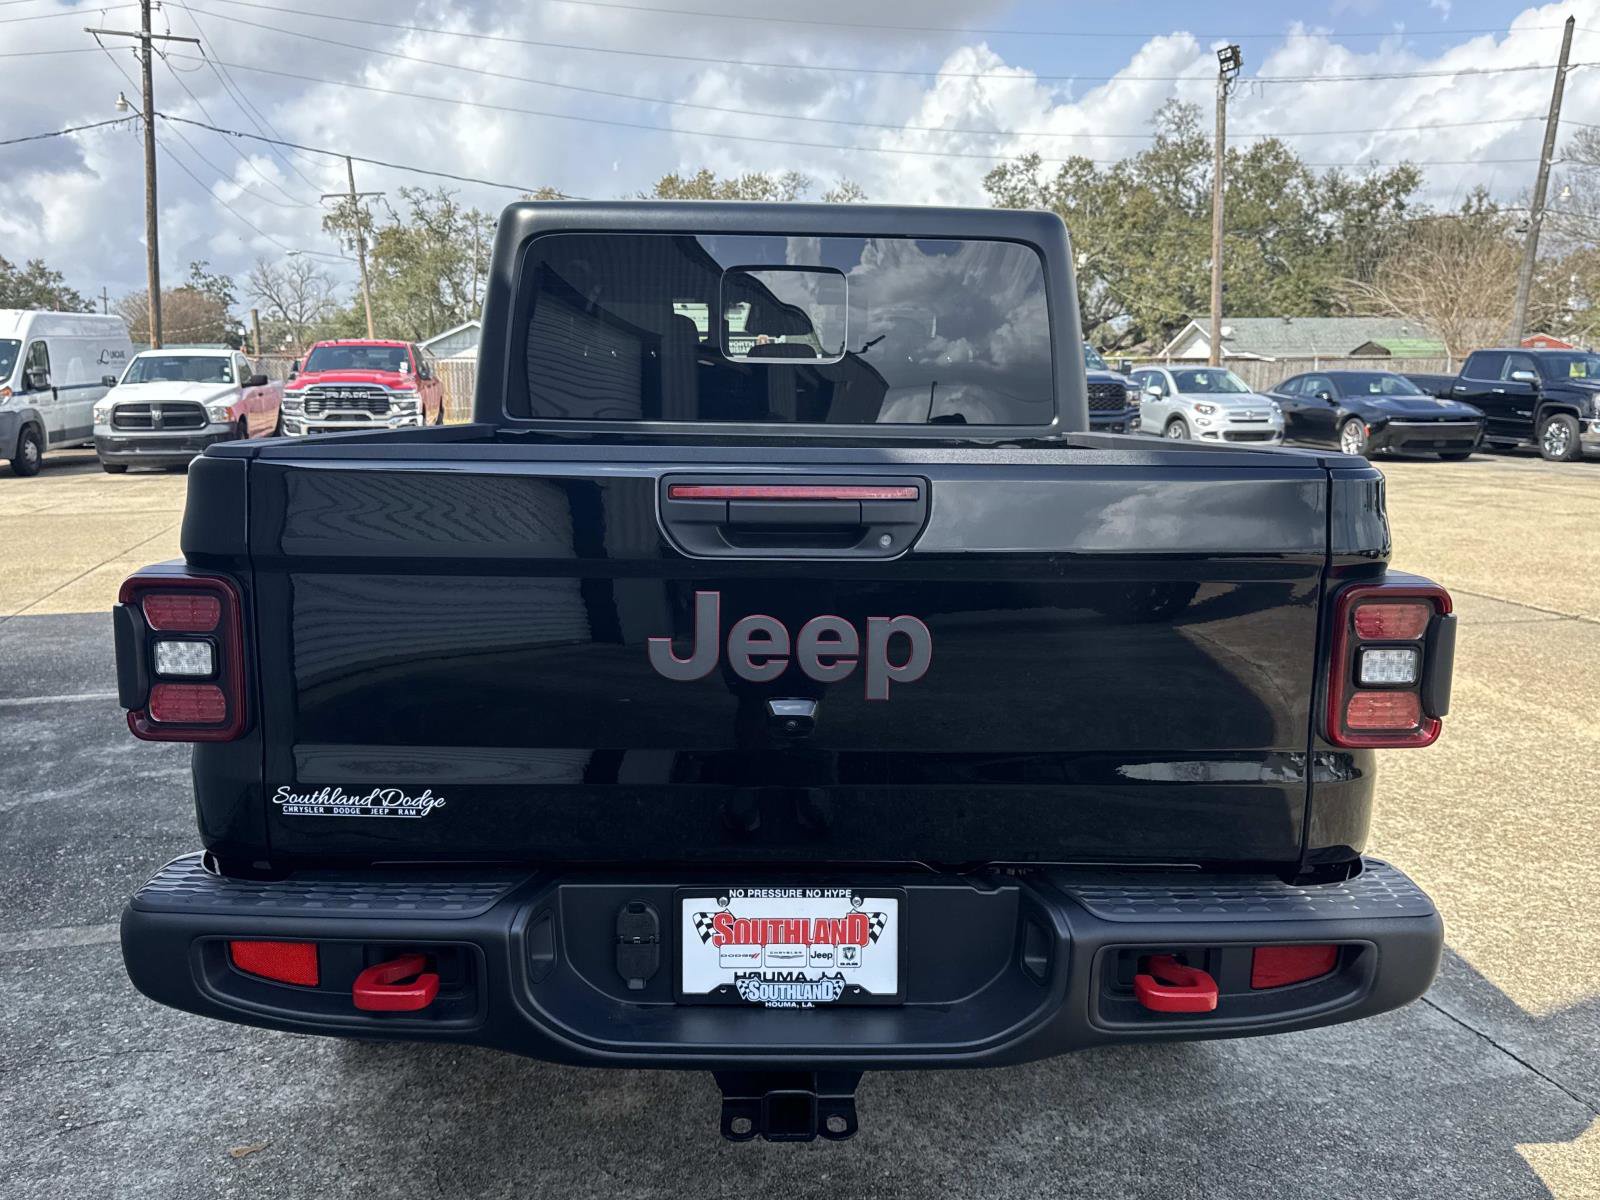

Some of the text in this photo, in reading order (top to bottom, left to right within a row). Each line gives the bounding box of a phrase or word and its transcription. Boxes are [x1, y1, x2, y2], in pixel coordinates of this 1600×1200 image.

[325, 391, 370, 399] RAM
[647, 590, 933, 701] Jeep
[272, 785, 447, 816] Southland Dodge
[283, 805, 417, 816] CHRYSLER DODGE JEEP RAM
[729, 889, 852, 898] NO PRESSURE NO HYPE
[712, 911, 869, 947] SOUTHLAND
[810, 950, 833, 961] Jeep
[748, 980, 834, 1001] SOUTHLAND
[765, 1001, 799, 1009] HOUMA,
